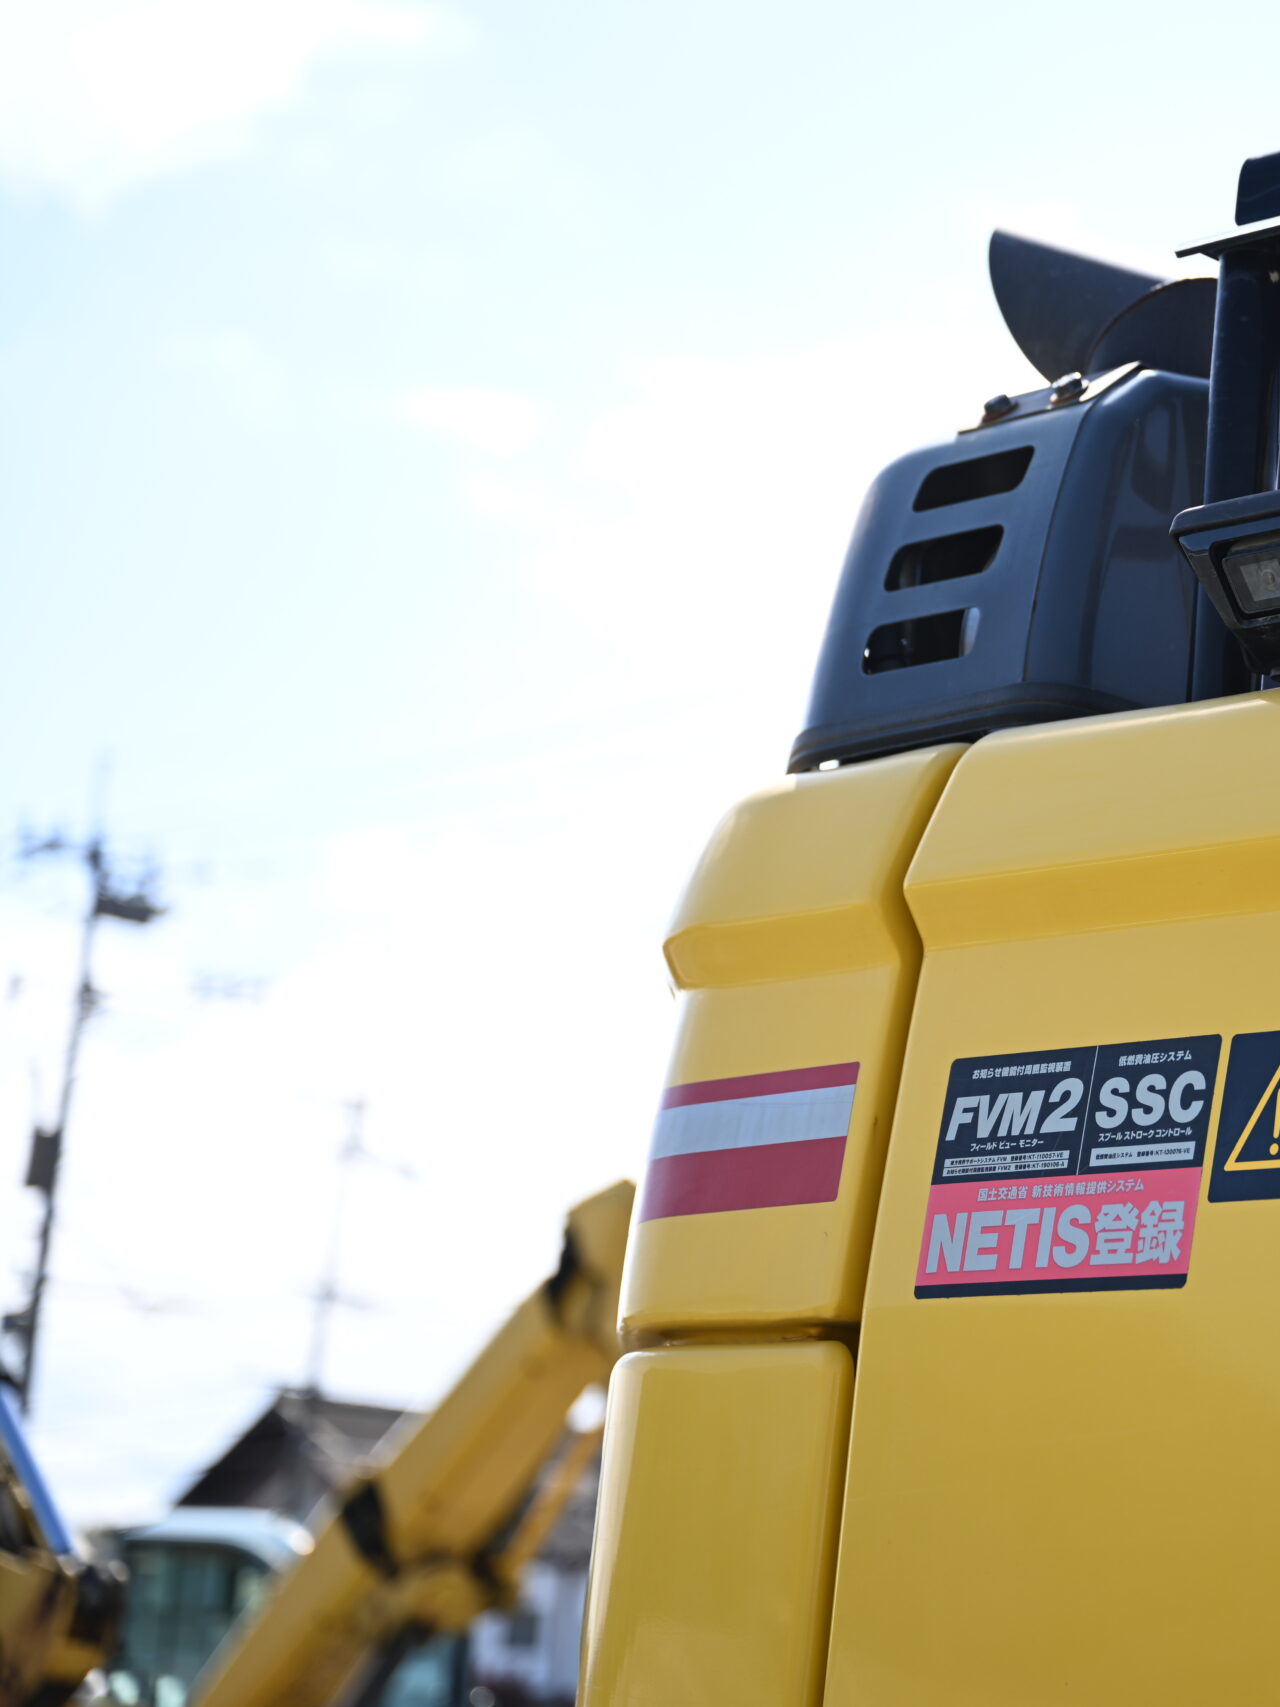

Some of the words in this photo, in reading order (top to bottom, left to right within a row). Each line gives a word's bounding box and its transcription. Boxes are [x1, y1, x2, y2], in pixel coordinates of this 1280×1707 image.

[1118, 1050, 1193, 1067] 低燃費油圧システム
[945, 1077, 1084, 1142] FVM2
[1095, 1070, 1206, 1129] SSC
[970, 1141, 998, 1152] フィールド
[1018, 1138, 1045, 1148] モニター
[1124, 1129, 1155, 1140] ストローク
[1155, 1126, 1192, 1138] コントロール
[977, 1187, 1028, 1202] 国土交通省
[1031, 1178, 1145, 1199] 新技術情報提供システム
[925, 1200, 1185, 1274] NETIS登録
